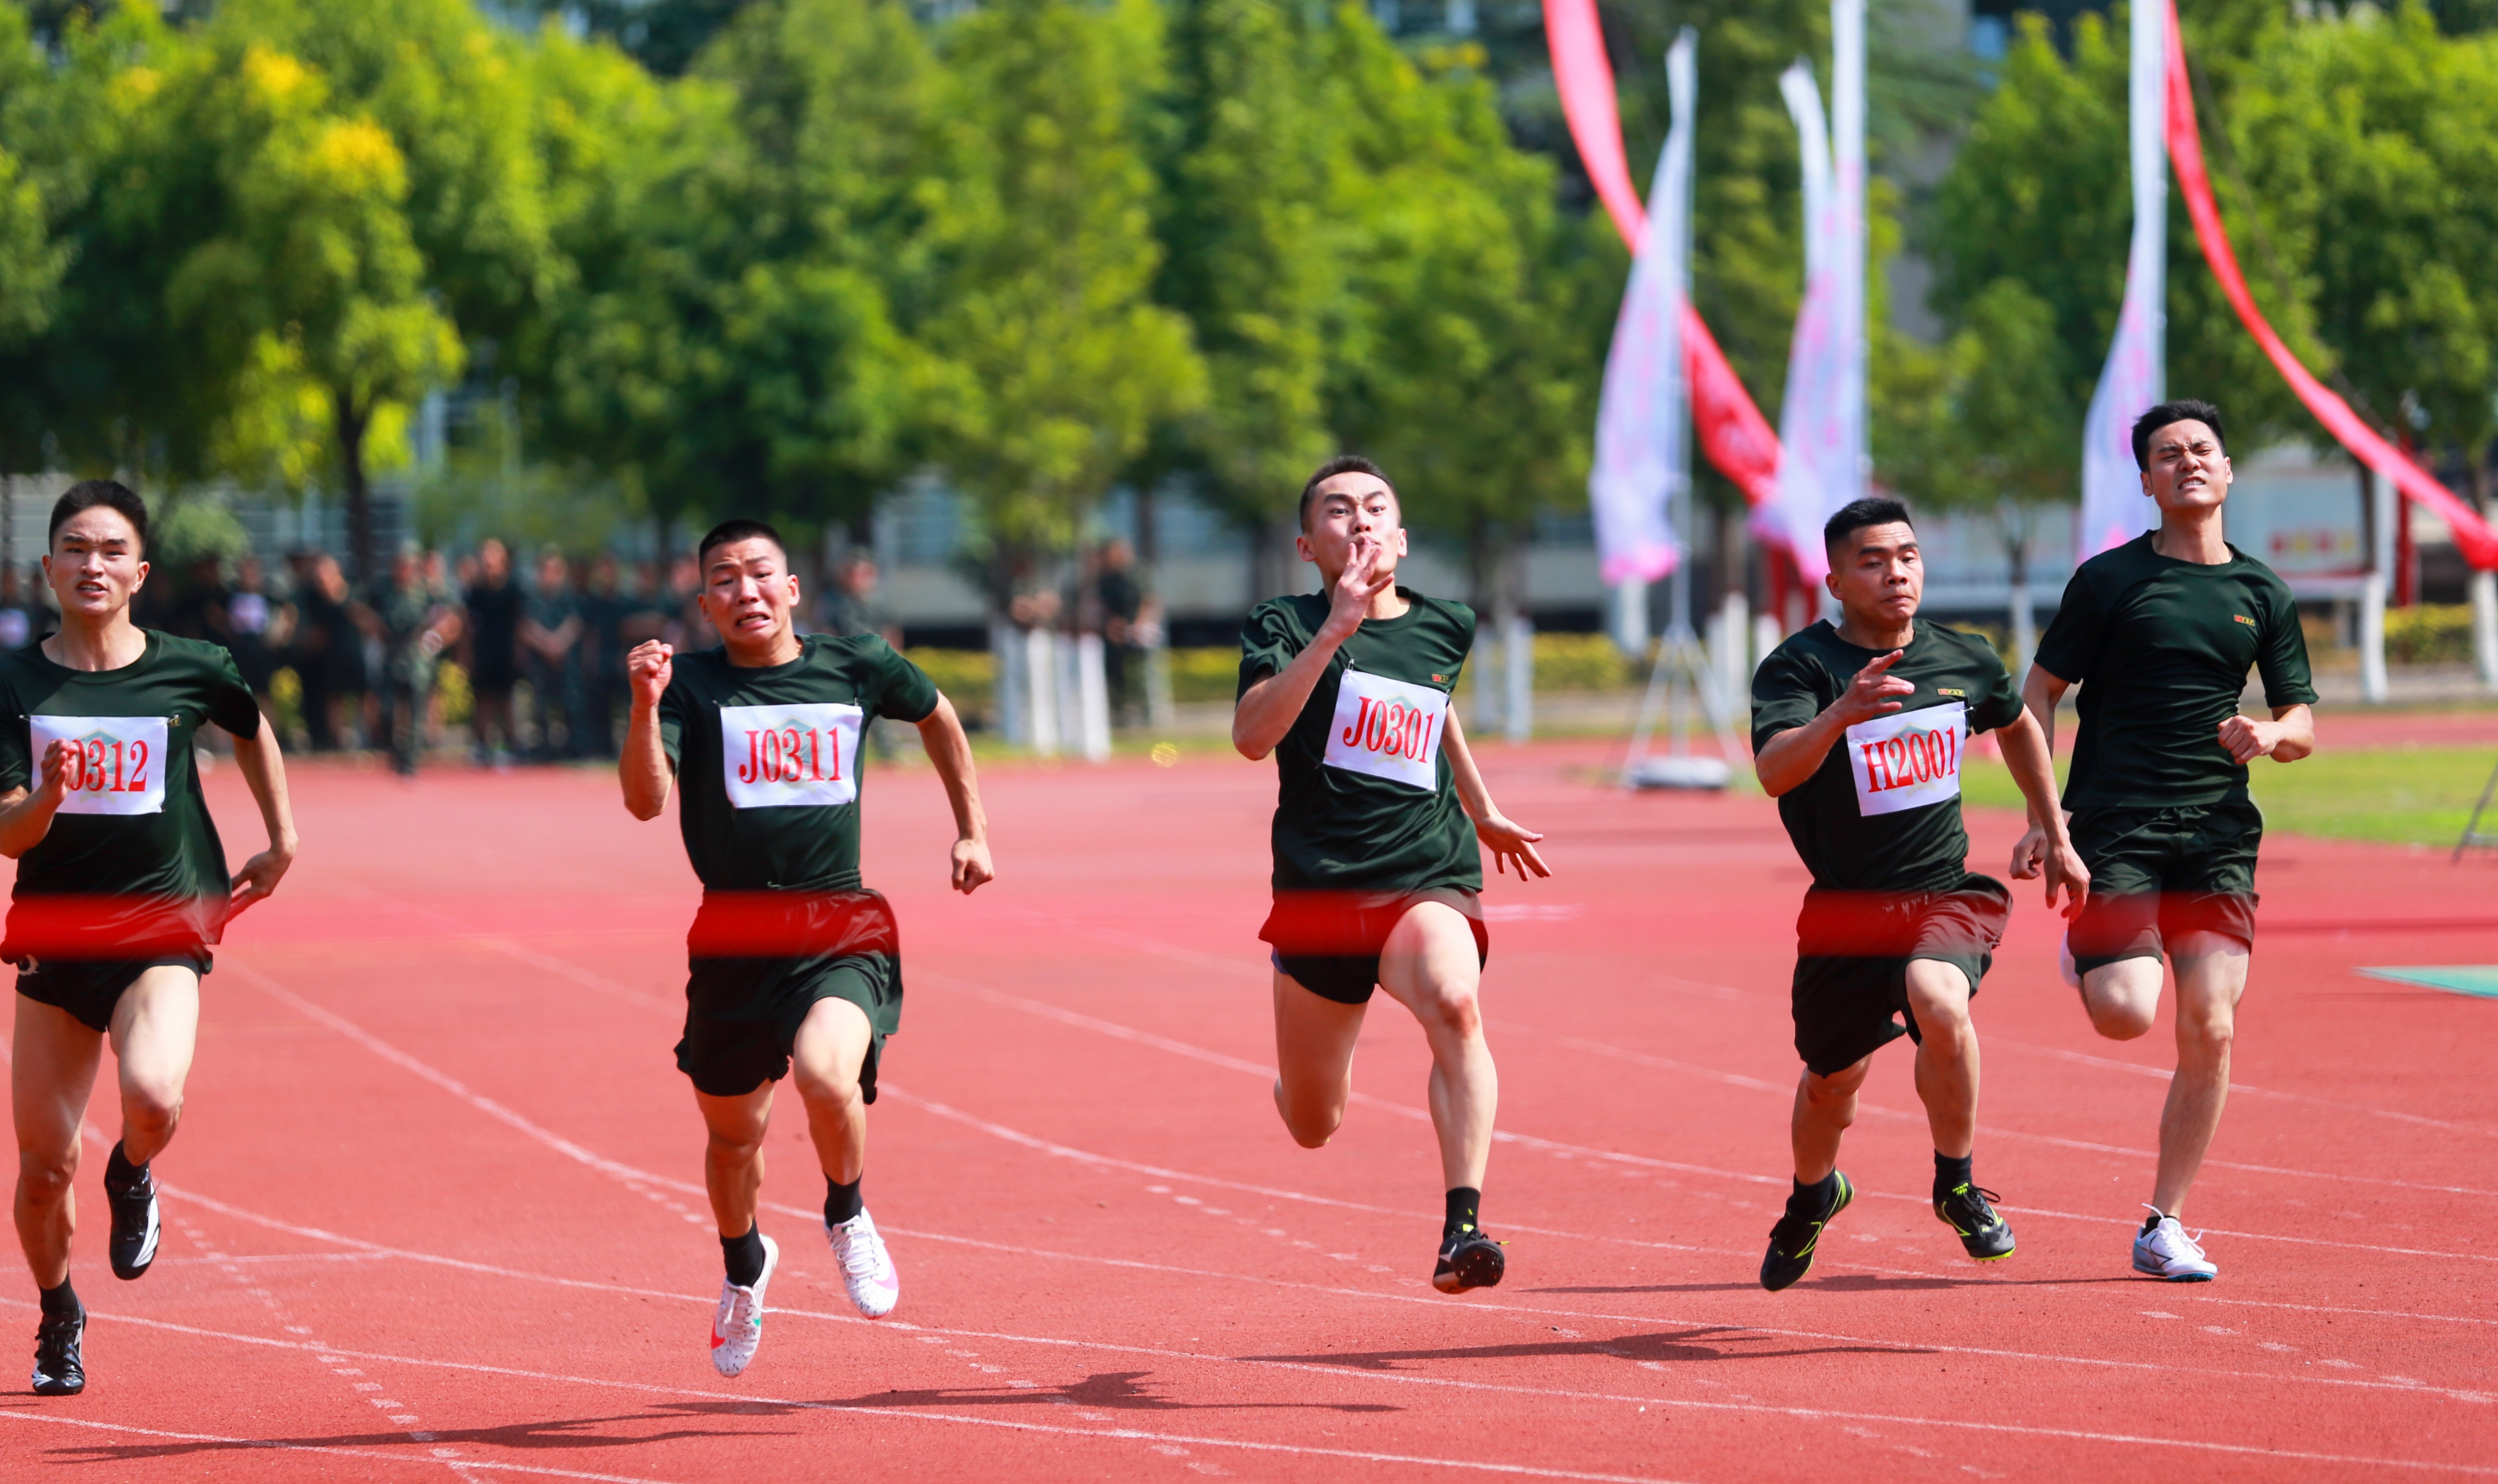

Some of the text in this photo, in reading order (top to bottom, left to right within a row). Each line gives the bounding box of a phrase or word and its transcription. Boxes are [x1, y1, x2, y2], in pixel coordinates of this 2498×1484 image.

[739, 726, 842, 784] J0311
[1343, 696, 1434, 764] J0301
[1860, 726, 1956, 793] H2001
[51, 739, 149, 792] 0312
